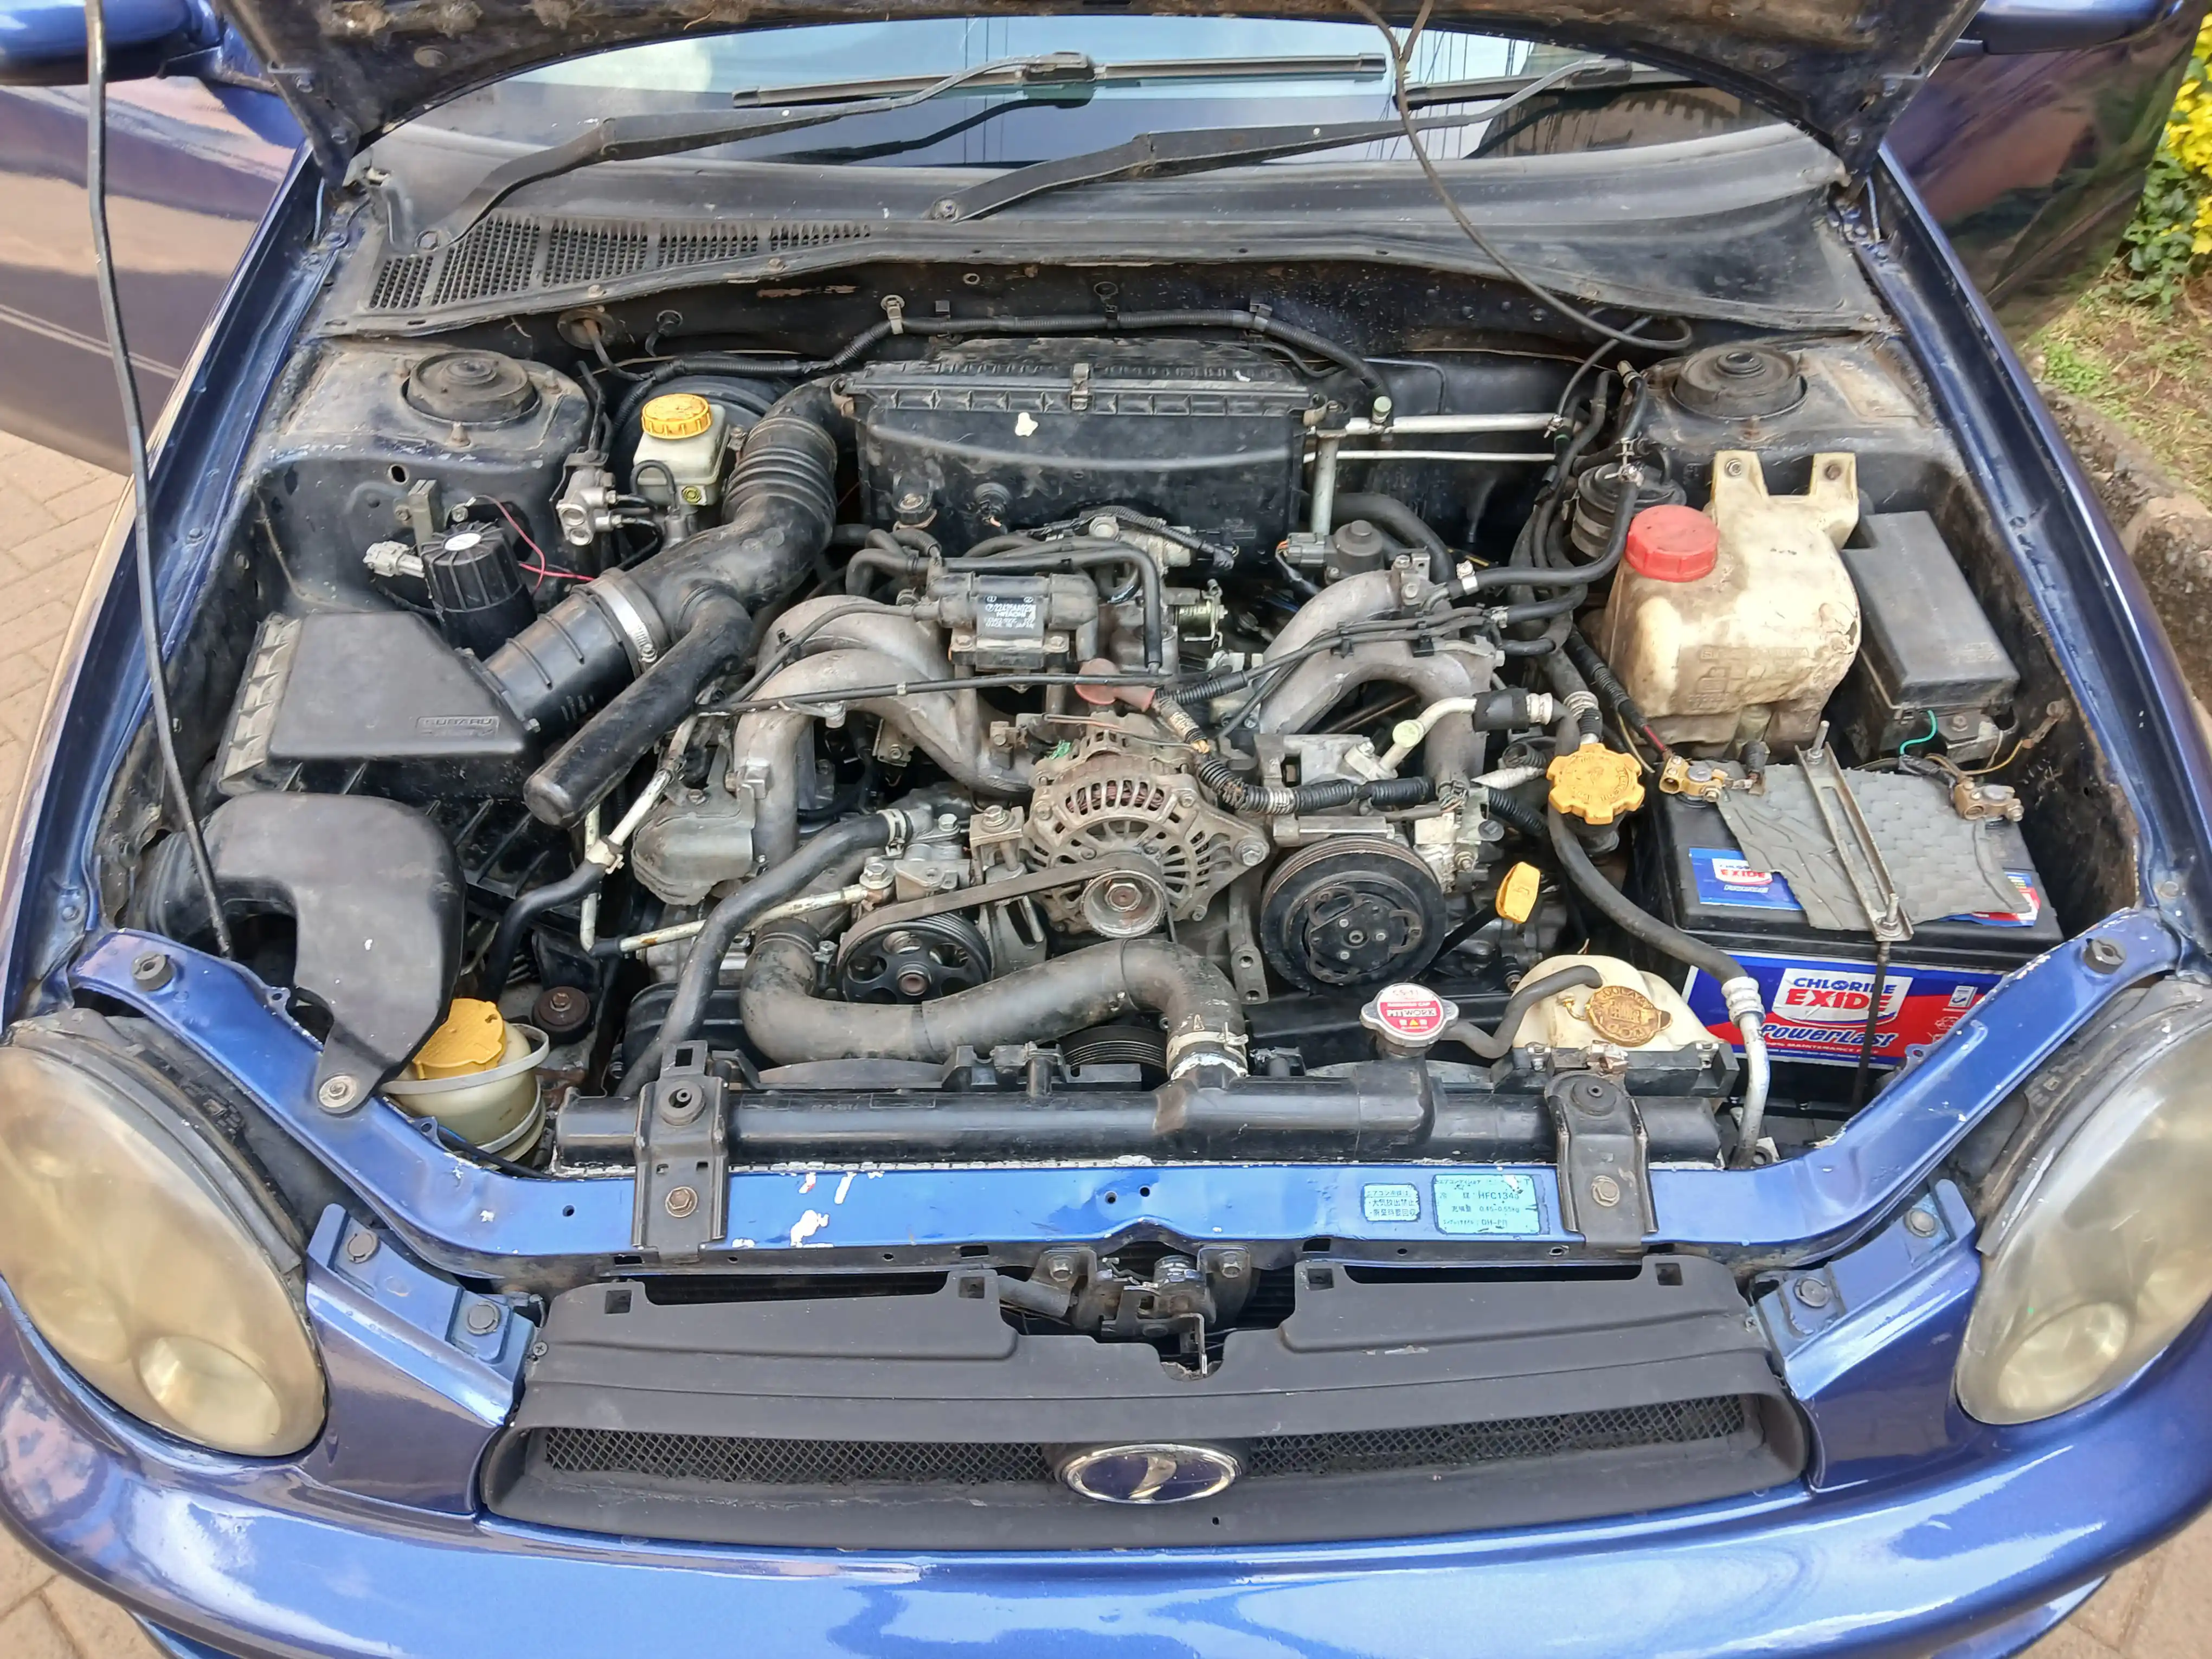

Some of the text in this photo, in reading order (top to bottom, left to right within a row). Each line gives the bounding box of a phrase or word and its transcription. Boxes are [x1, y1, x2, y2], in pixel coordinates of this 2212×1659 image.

[1720, 869, 1766, 878] EXIDE
[1785, 988, 1893, 1012] EXIDE
[1478, 1192, 1519, 1200] HFC134a
